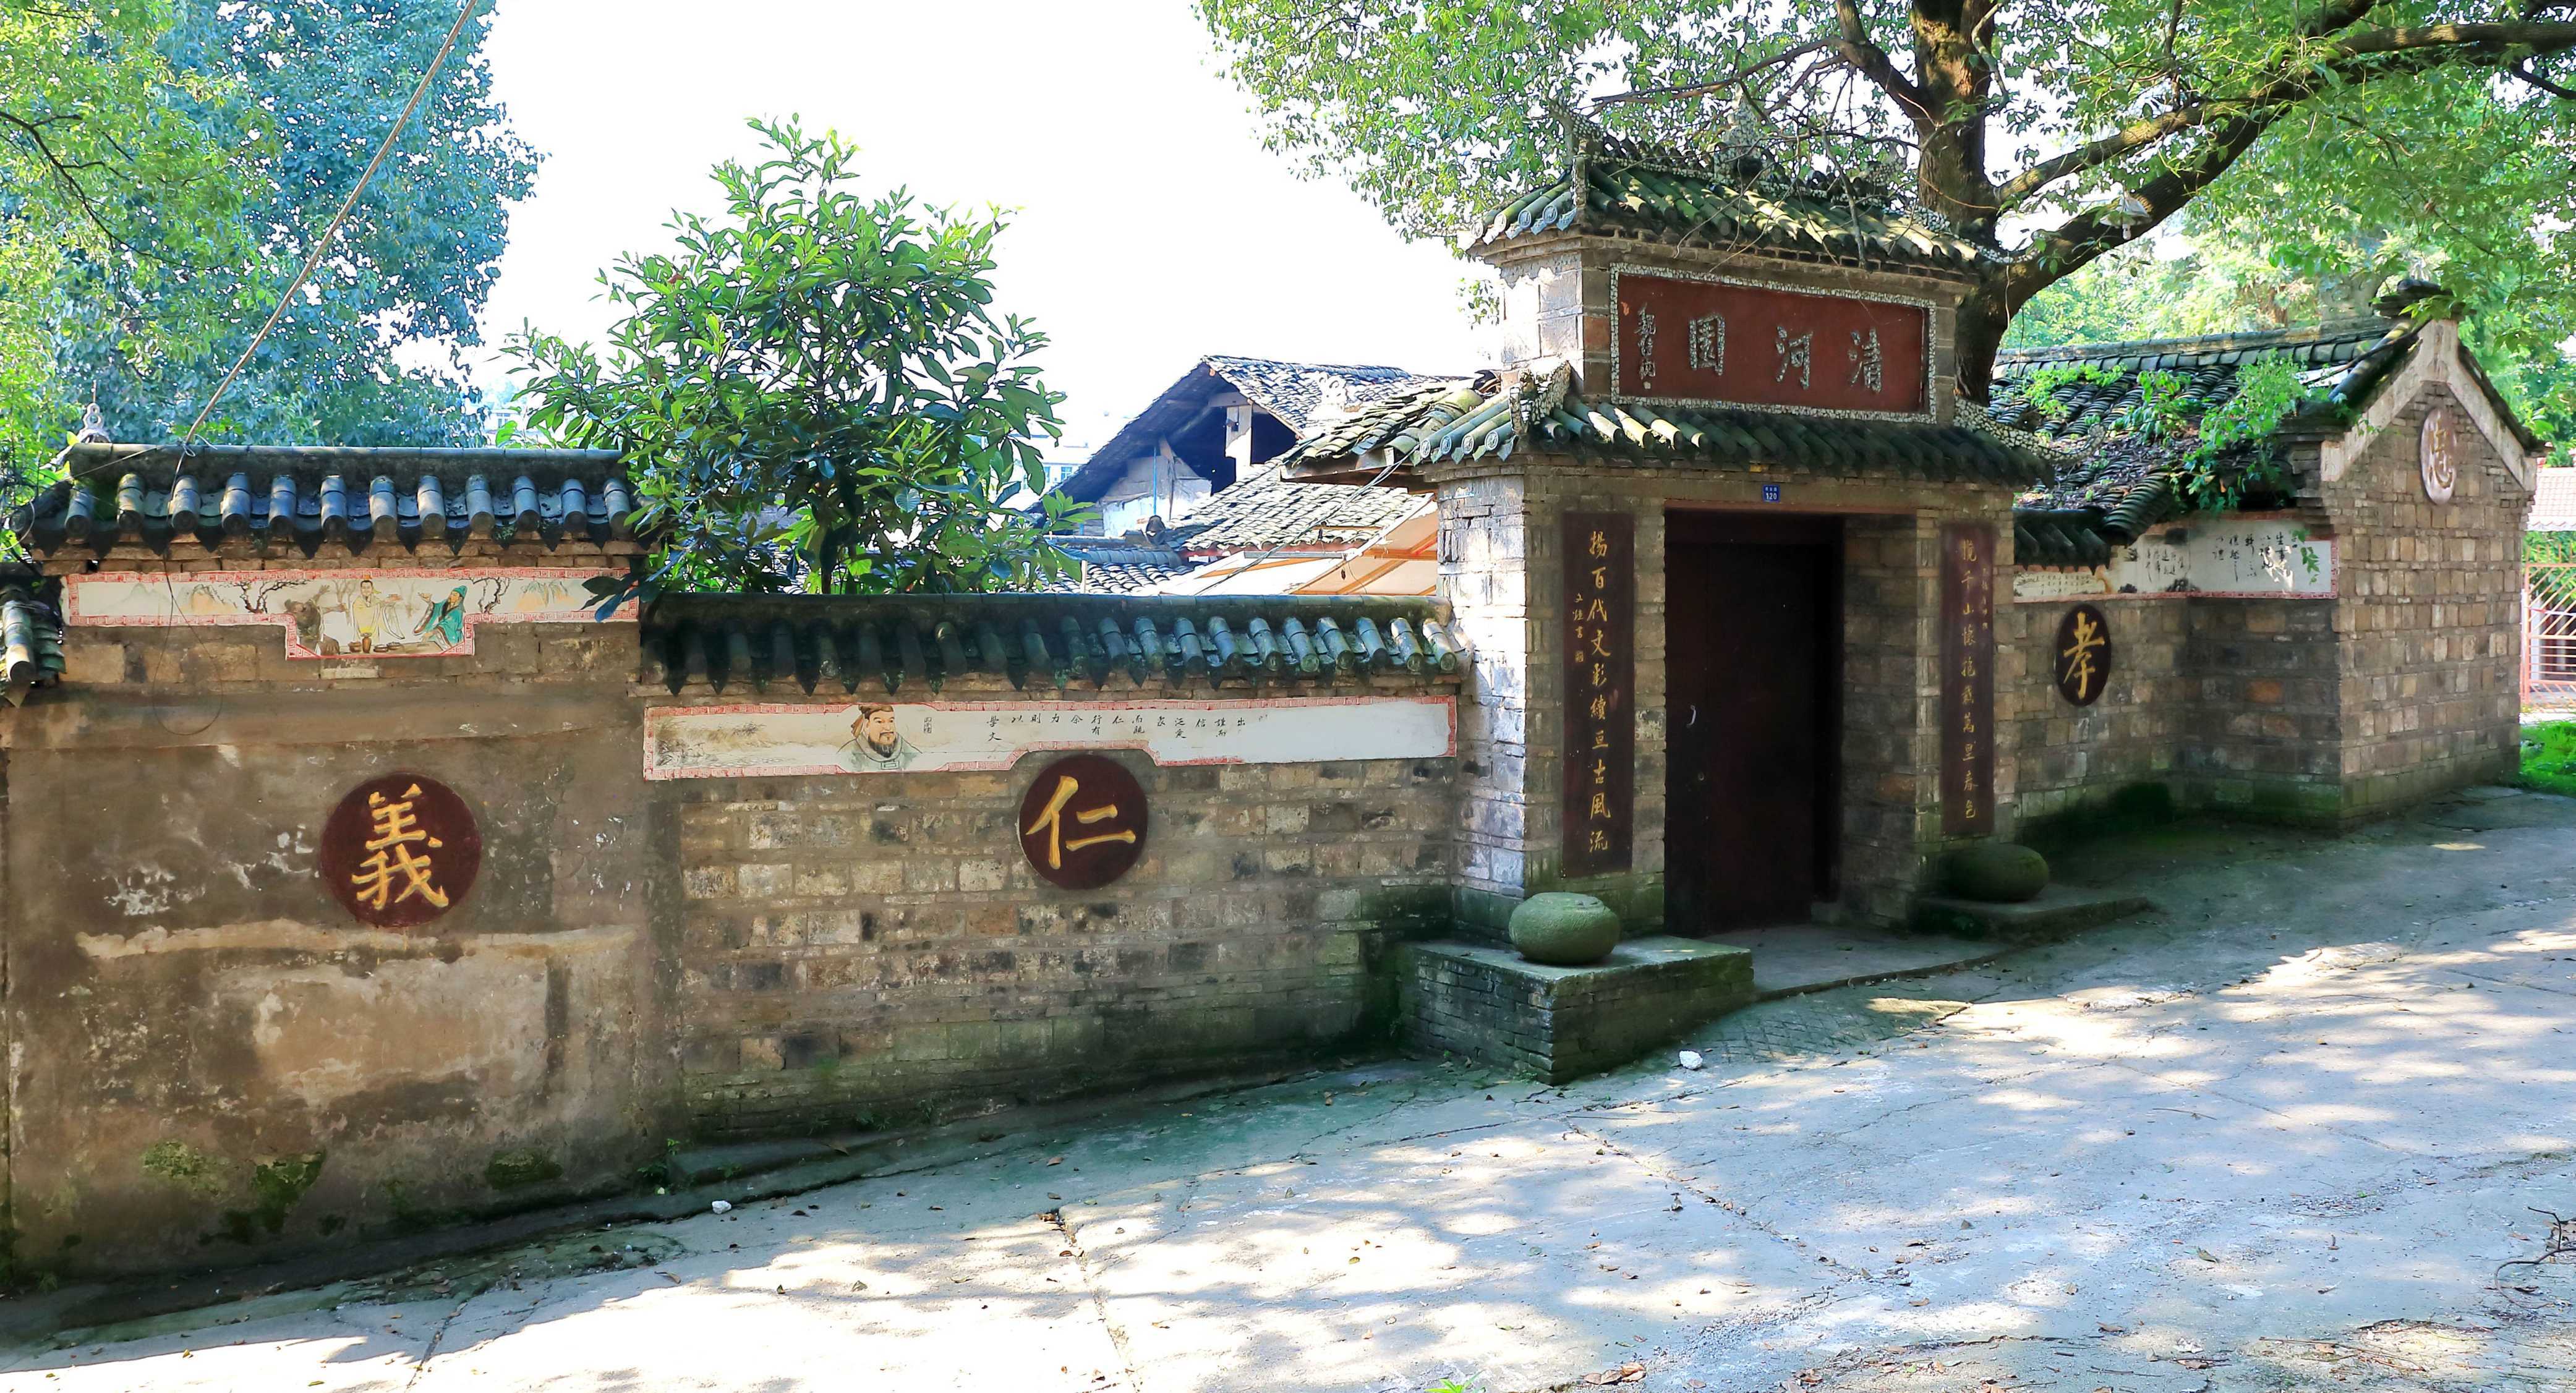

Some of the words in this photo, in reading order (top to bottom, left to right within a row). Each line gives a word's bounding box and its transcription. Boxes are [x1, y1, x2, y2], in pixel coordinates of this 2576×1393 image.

[1689, 312, 1883, 393] 清河園
[1766, 492, 1778, 500] 120
[2063, 611, 2105, 699] 孝
[351, 783, 449, 910] 義
[1025, 775, 1137, 870] 仁
